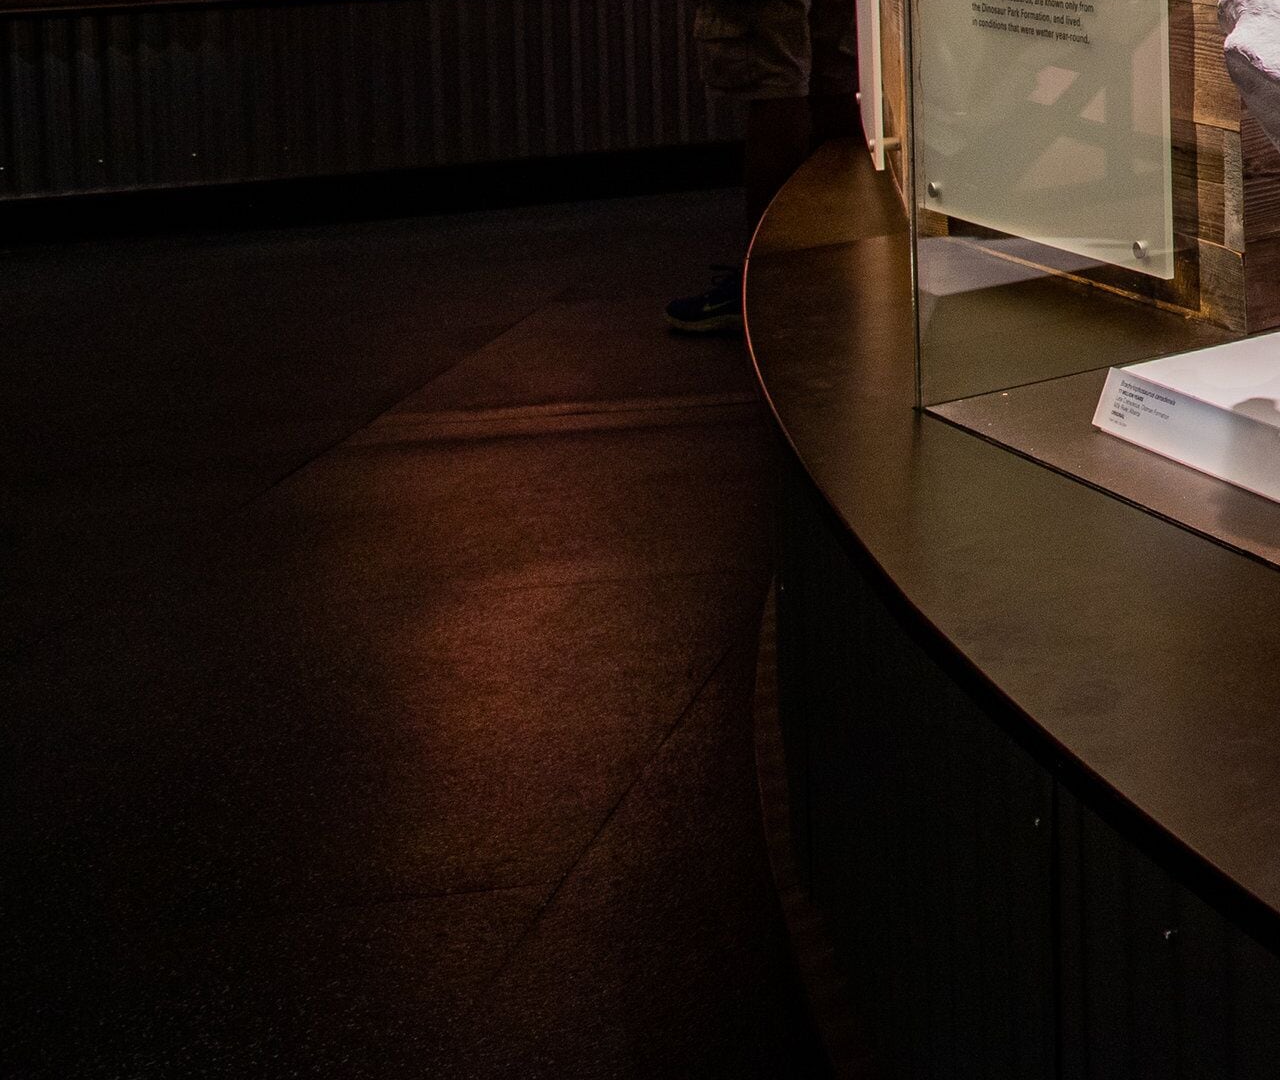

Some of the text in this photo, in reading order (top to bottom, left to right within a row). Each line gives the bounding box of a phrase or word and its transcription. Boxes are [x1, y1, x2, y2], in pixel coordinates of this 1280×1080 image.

[972, 2, 981, 11] the
[982, 4, 1006, 15] Dinosaur
[1008, 8, 1020, 17] Park
[1053, 16, 1065, 24] and
[1066, 17, 1080, 26] lived
[1065, 1, 1078, 11] only
[1080, 2, 1094, 11] from
[979, 20, 1007, 30] conditions
[1008, 23, 1019, 32] that
[1036, 28, 1054, 37] wetter
